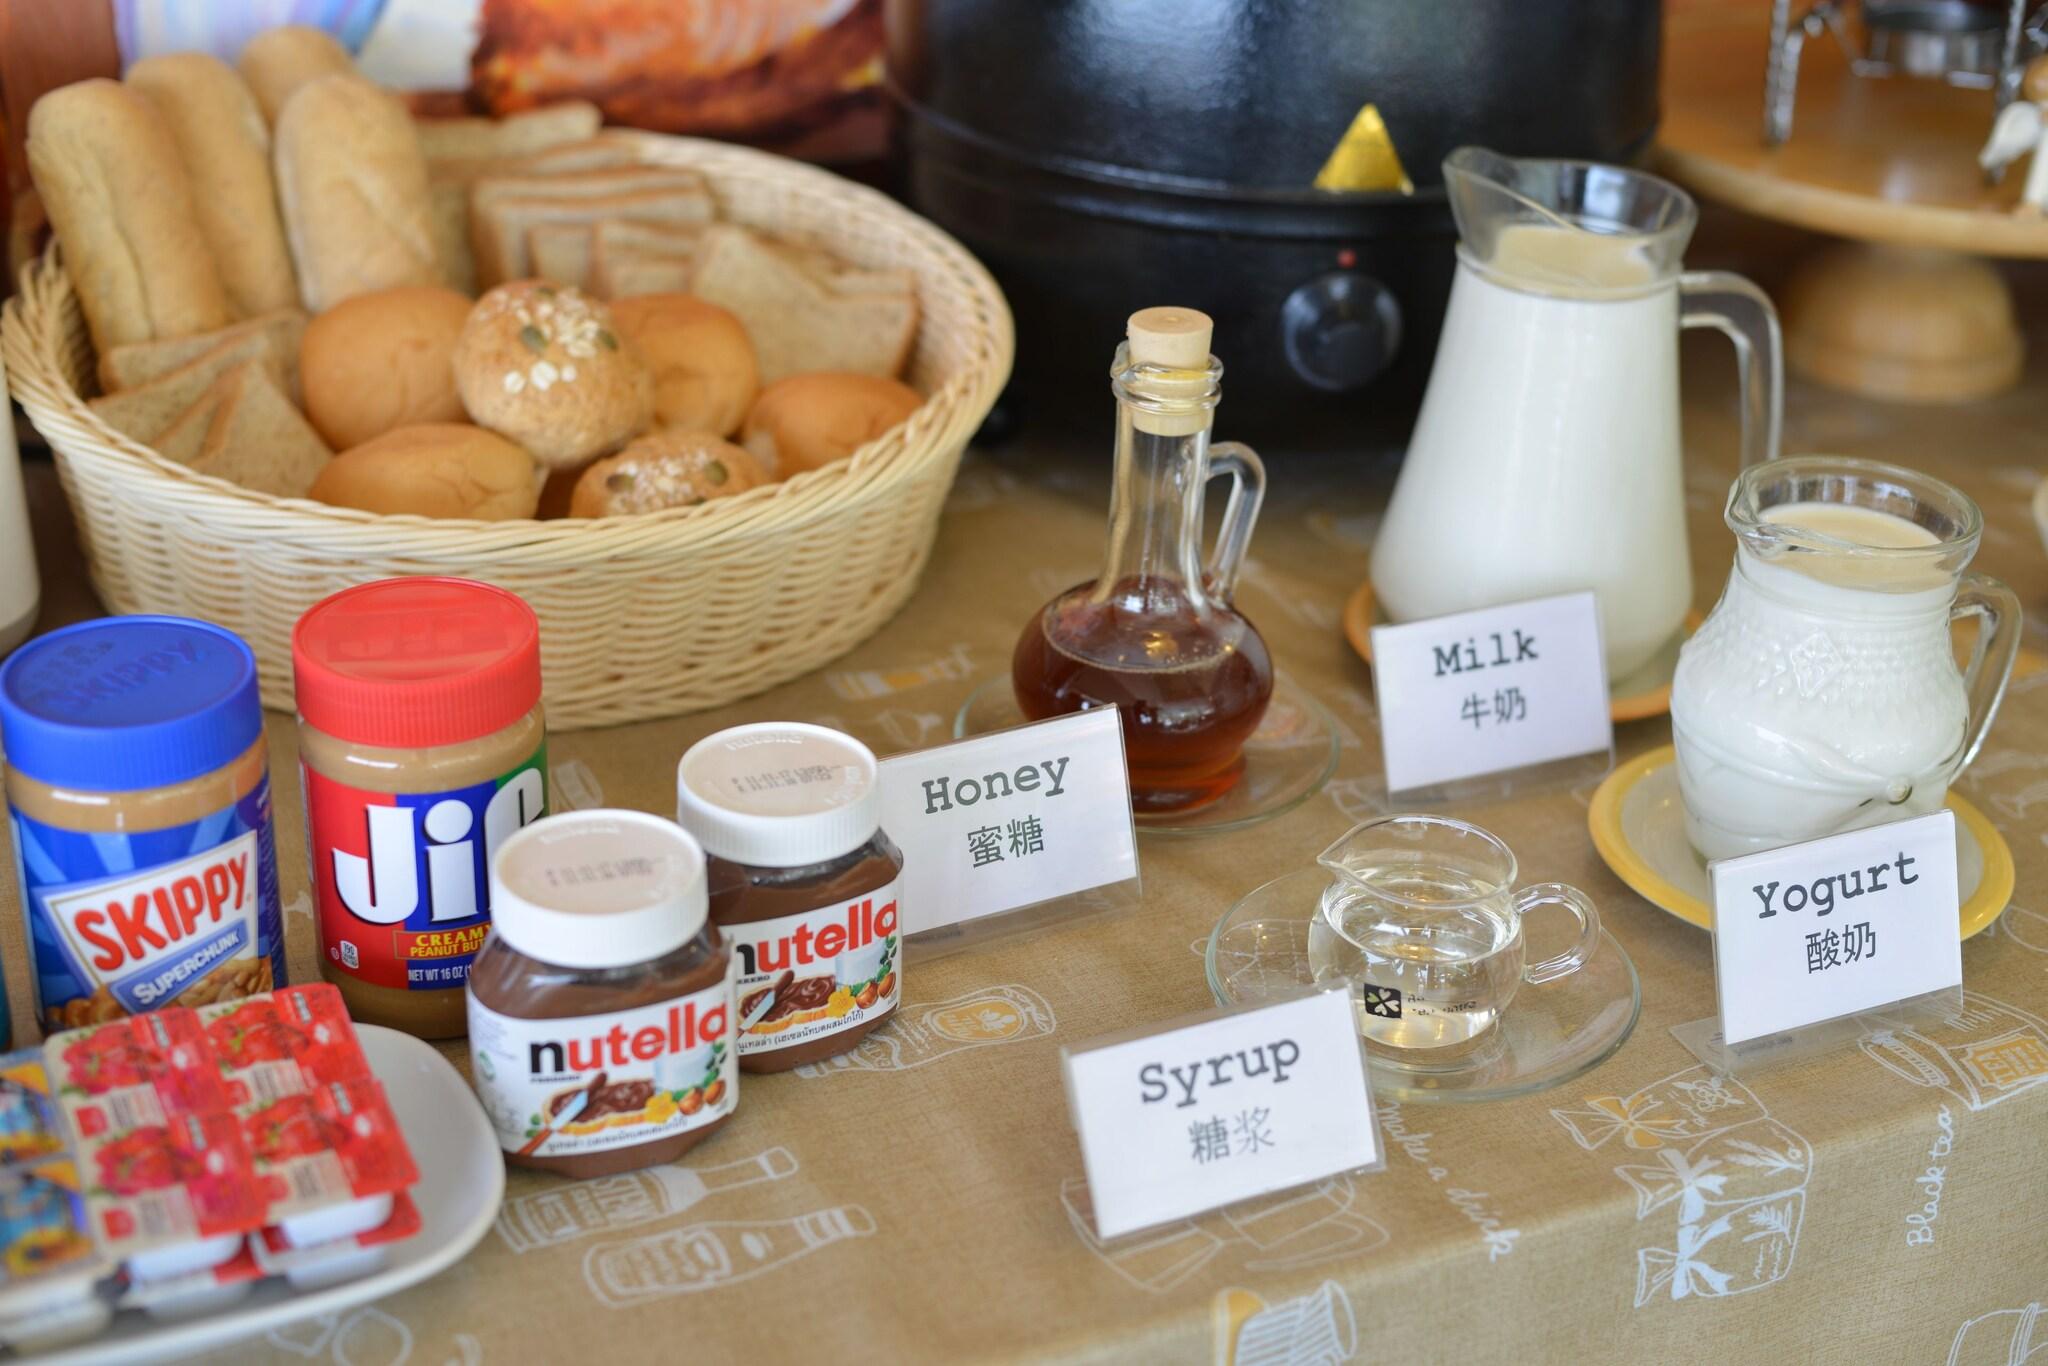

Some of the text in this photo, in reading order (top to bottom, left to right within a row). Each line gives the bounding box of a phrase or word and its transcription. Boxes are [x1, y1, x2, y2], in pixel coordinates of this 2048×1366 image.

[1433, 629, 1539, 677] Milk
[1460, 686, 1527, 729] 牛奶
[921, 756, 1070, 814] Honey
[967, 814, 1044, 868] 蜜糖
[74, 851, 249, 972] SKIPPY
[1752, 851, 1919, 919] Yogurt
[132, 927, 242, 1004] SUPERCHUNK
[409, 943, 460, 958] PEANUT
[736, 898, 897, 975] nutella
[1804, 921, 1876, 975] 酸奶
[408, 969, 423, 982] NET
[425, 967, 439, 981] WT
[440, 967, 451, 980] 16
[452, 965, 463, 979] OZ
[529, 1001, 727, 1074] nutella
[1139, 1039, 1300, 1108] Syrup
[1188, 1106, 1275, 1165] 糖浆
[1906, 1103, 1954, 1247] Black tea
